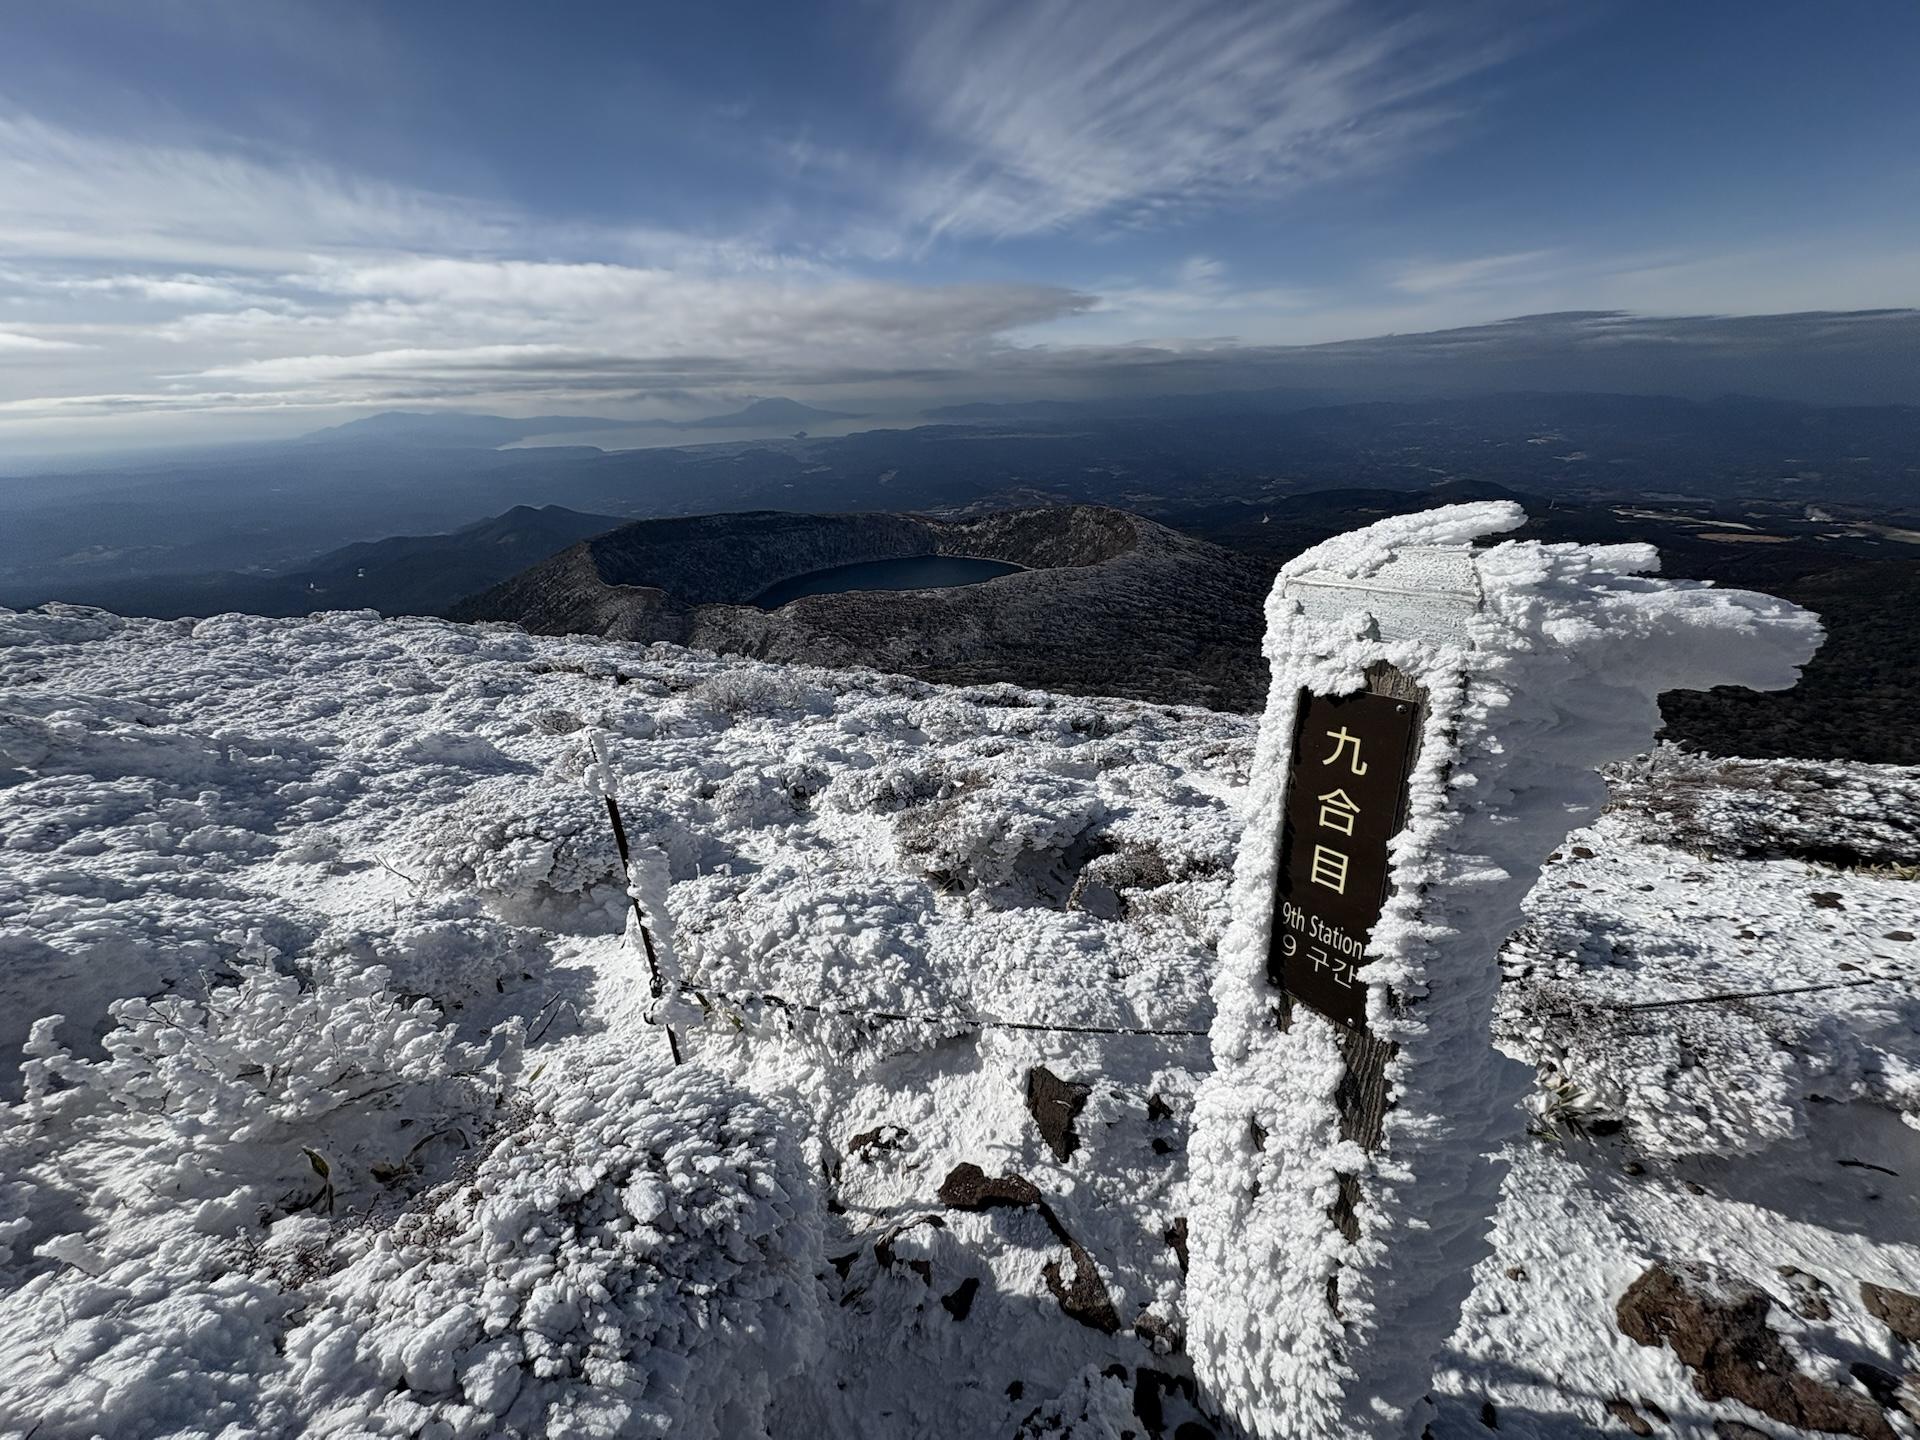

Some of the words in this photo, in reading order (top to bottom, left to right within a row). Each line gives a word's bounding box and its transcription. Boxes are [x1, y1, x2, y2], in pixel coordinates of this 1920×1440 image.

[1311, 726, 1368, 895] 九合目
[1282, 902, 1305, 932] 9th
[1309, 915, 1363, 960] Station
[1282, 934, 1297, 956] 9
[1306, 946, 1357, 989] 구간
